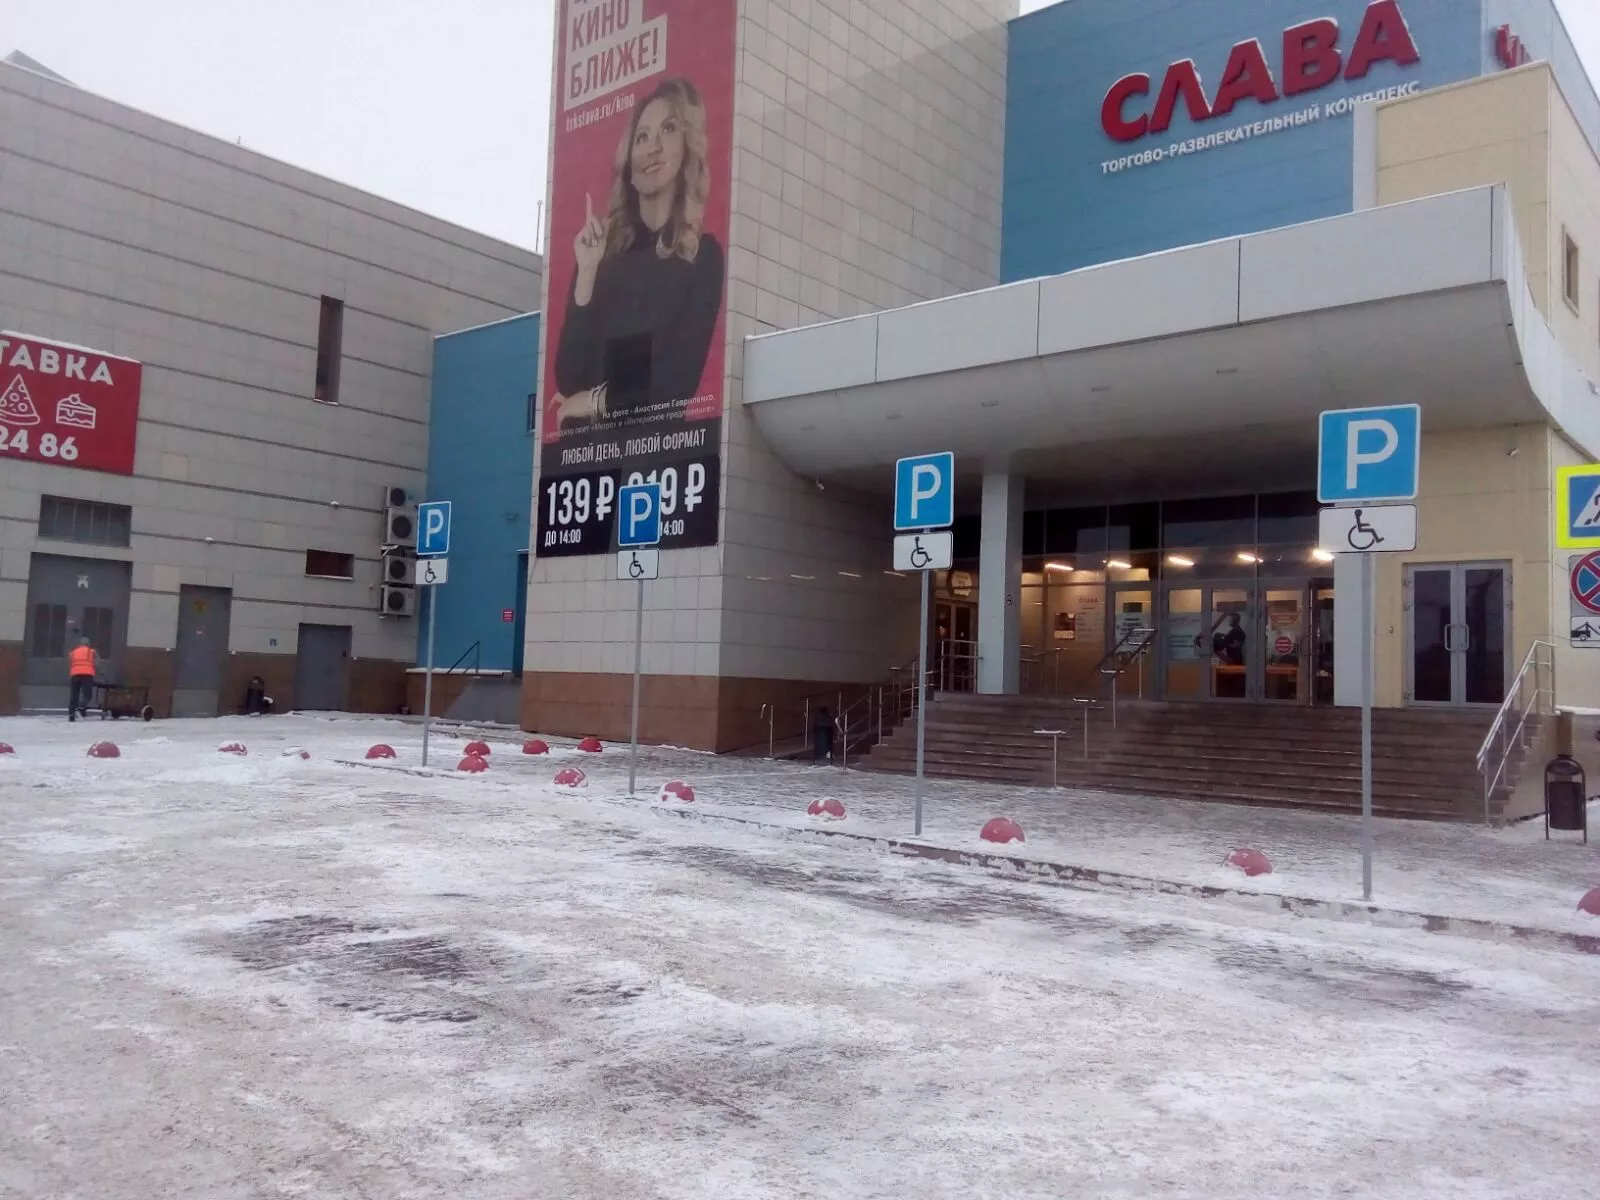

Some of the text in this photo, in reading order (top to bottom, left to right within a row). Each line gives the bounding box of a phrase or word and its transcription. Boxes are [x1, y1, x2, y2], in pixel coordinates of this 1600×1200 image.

[572, 0, 629, 52] КИНО
[571, 27, 658, 99] БЛИЖЕ!
[1100, 0, 1420, 143] СЛАВА
[1100, 102, 1320, 175] ТОРГОВО-РАЗВЛЕКАТЕЛЬНЫЙ
[39, 432, 79, 461] 86
[561, 428, 707, 466] ЛЮБОЙ ДЕНЬ, ЛЮБОЙ ФОРМАТ
[547, 477, 591, 526] 139
[544, 528, 582, 547] ДО 14:00
